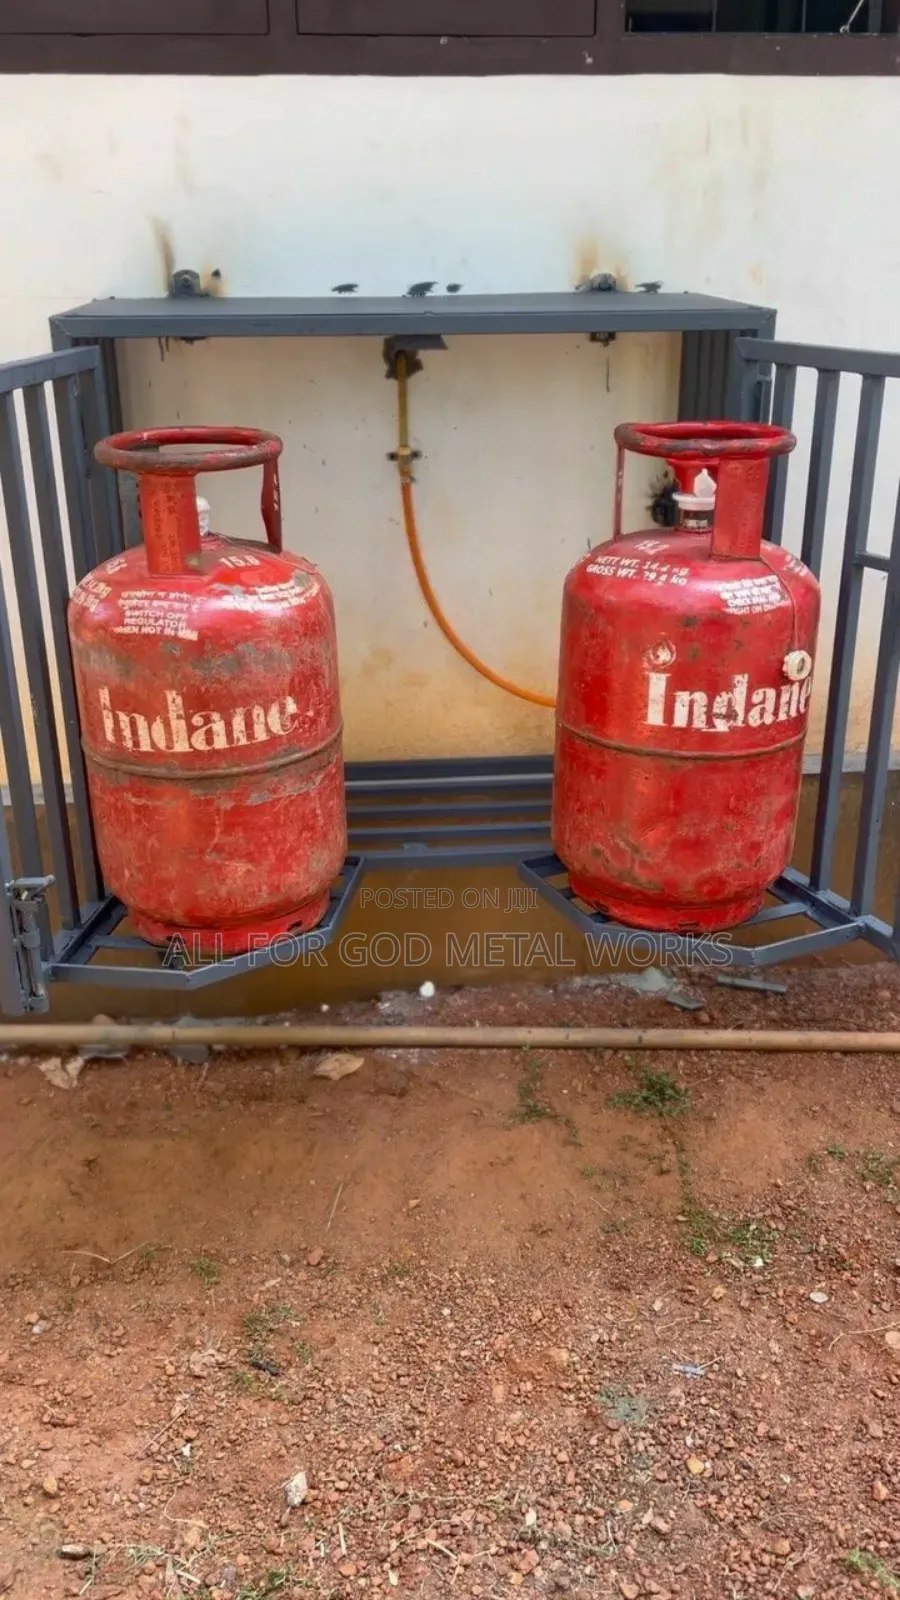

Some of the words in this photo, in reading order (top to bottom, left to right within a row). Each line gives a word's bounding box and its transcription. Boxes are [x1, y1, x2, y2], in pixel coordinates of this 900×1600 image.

[586, 564, 616, 576] GROSS
[125, 609, 164, 617] SWITCH
[140, 626, 162, 635] NOT
[642, 671, 813, 732] Indane
[98, 685, 300, 753] Indane
